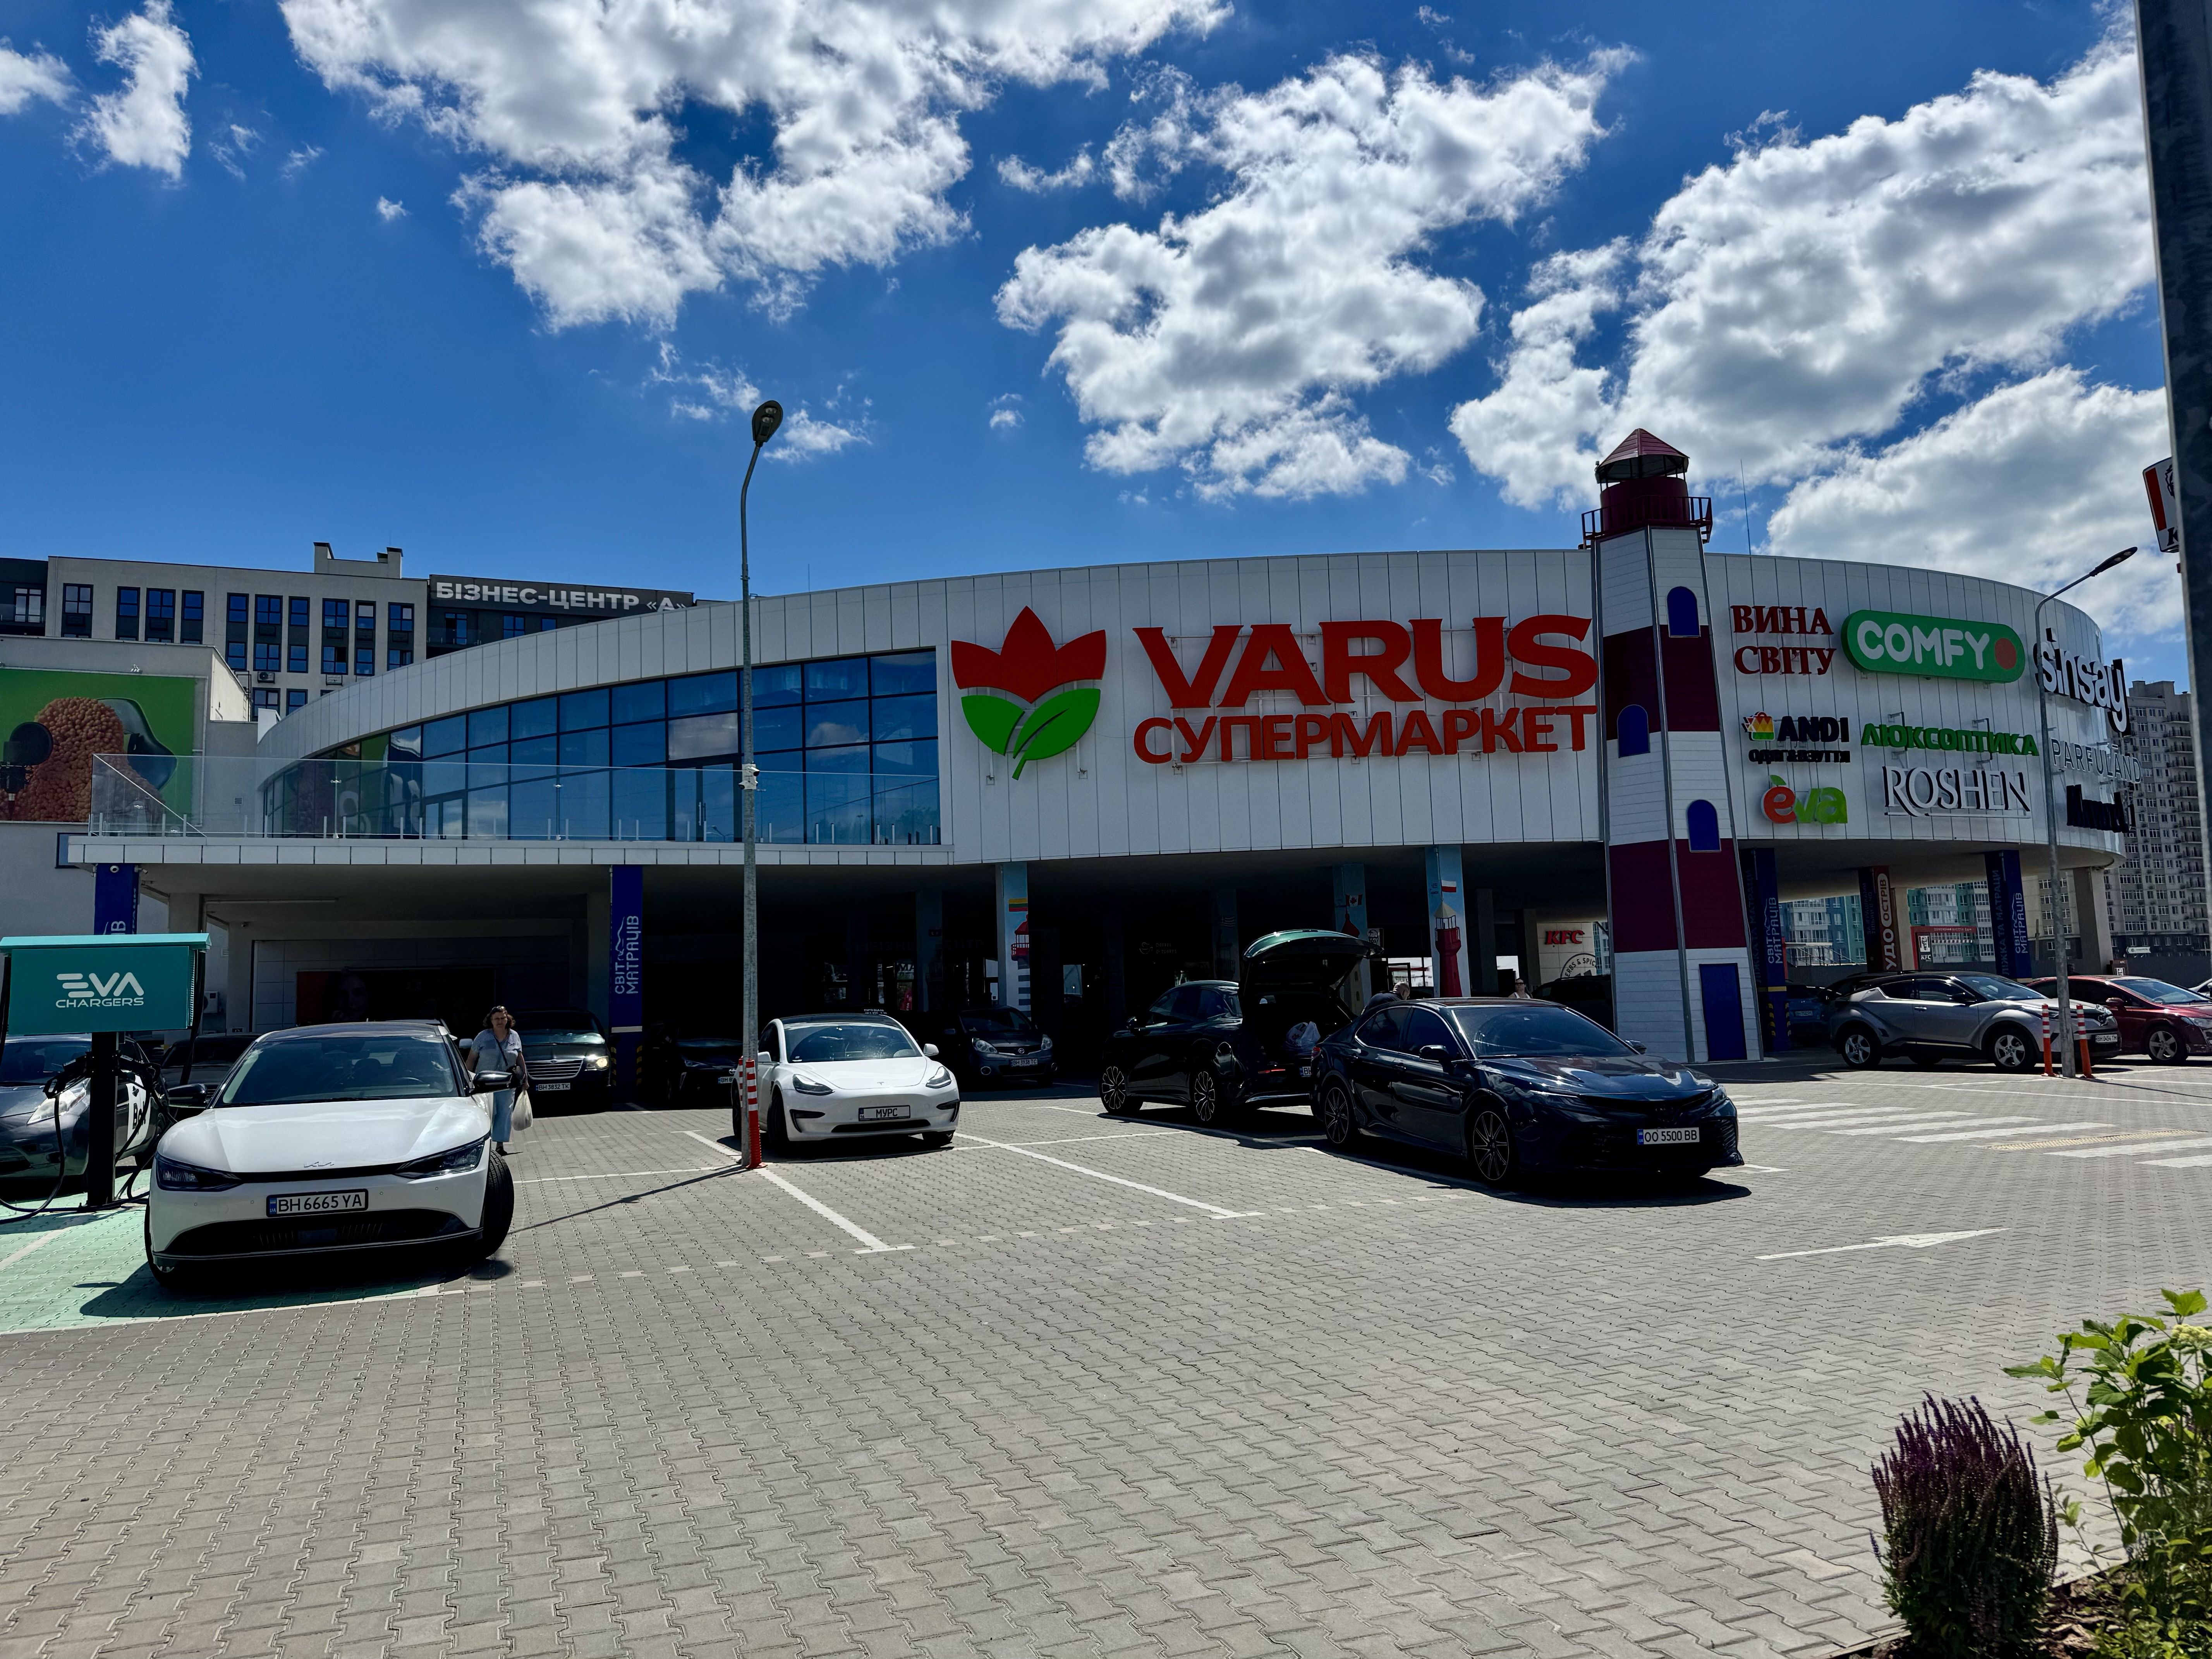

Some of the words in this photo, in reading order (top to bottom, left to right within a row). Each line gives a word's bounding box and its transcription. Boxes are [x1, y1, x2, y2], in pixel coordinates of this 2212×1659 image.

[436, 582, 639, 610] БІЗНЕС-ЦЕНТР
[1730, 605, 1834, 635] ВИНА
[1734, 646, 1836, 675] СВІТУ
[1857, 620, 1990, 670] COMFY
[1132, 614, 1599, 709] VARUS
[2033, 628, 2130, 736] sinsay
[1133, 705, 1597, 764] СУПЕРМАРКЕТ
[1777, 716, 1850, 742] ANDI
[1860, 723, 2040, 756] ЛЮКСОПТИКА
[1882, 766, 2031, 817] ROSHEN
[1880, 879, 1890, 921] ОСТРІВ
[1546, 930, 1585, 945] KFC
[1882, 928, 1897, 970] УДО
[626, 916, 641, 994] МАТРАЦІВ
[1565, 962, 1576, 977] ERBS
[1583, 958, 1595, 966] SPIC
[57, 972, 144, 998] EVA
[615, 962, 625, 994] СВІТ
[55, 997, 144, 1008] CHARGERS
[1644, 1132, 1659, 1142] OO
[1661, 1131, 1682, 1141] 5500
[1685, 1130, 1697, 1140] BB
[278, 1198, 301, 1212] BH
[304, 1195, 338, 1210] 6665
[342, 1194, 362, 1208] YA
